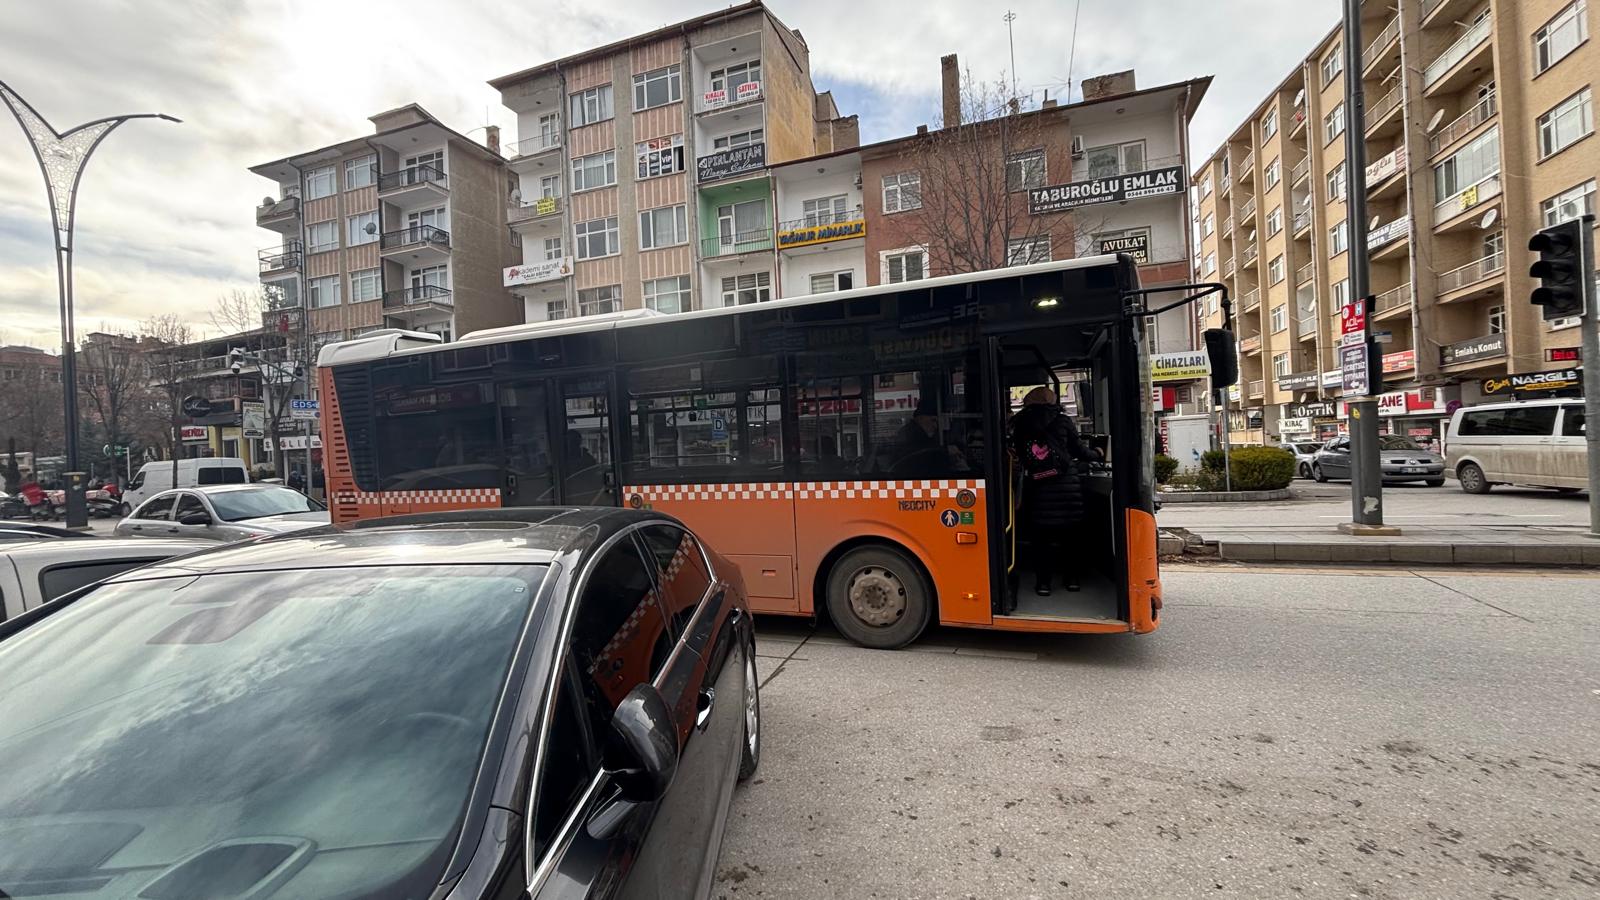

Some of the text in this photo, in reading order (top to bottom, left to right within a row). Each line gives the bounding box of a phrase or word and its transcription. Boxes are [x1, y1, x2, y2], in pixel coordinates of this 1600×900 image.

[1032, 170, 1178, 204] TABUROĞLU EMLAK
[1103, 237, 1145, 252] AVUKAT
[1478, 340, 1502, 352] Konut
[1156, 356, 1206, 369] CİHAZLARI
[898, 500, 936, 511] NEOCITY
